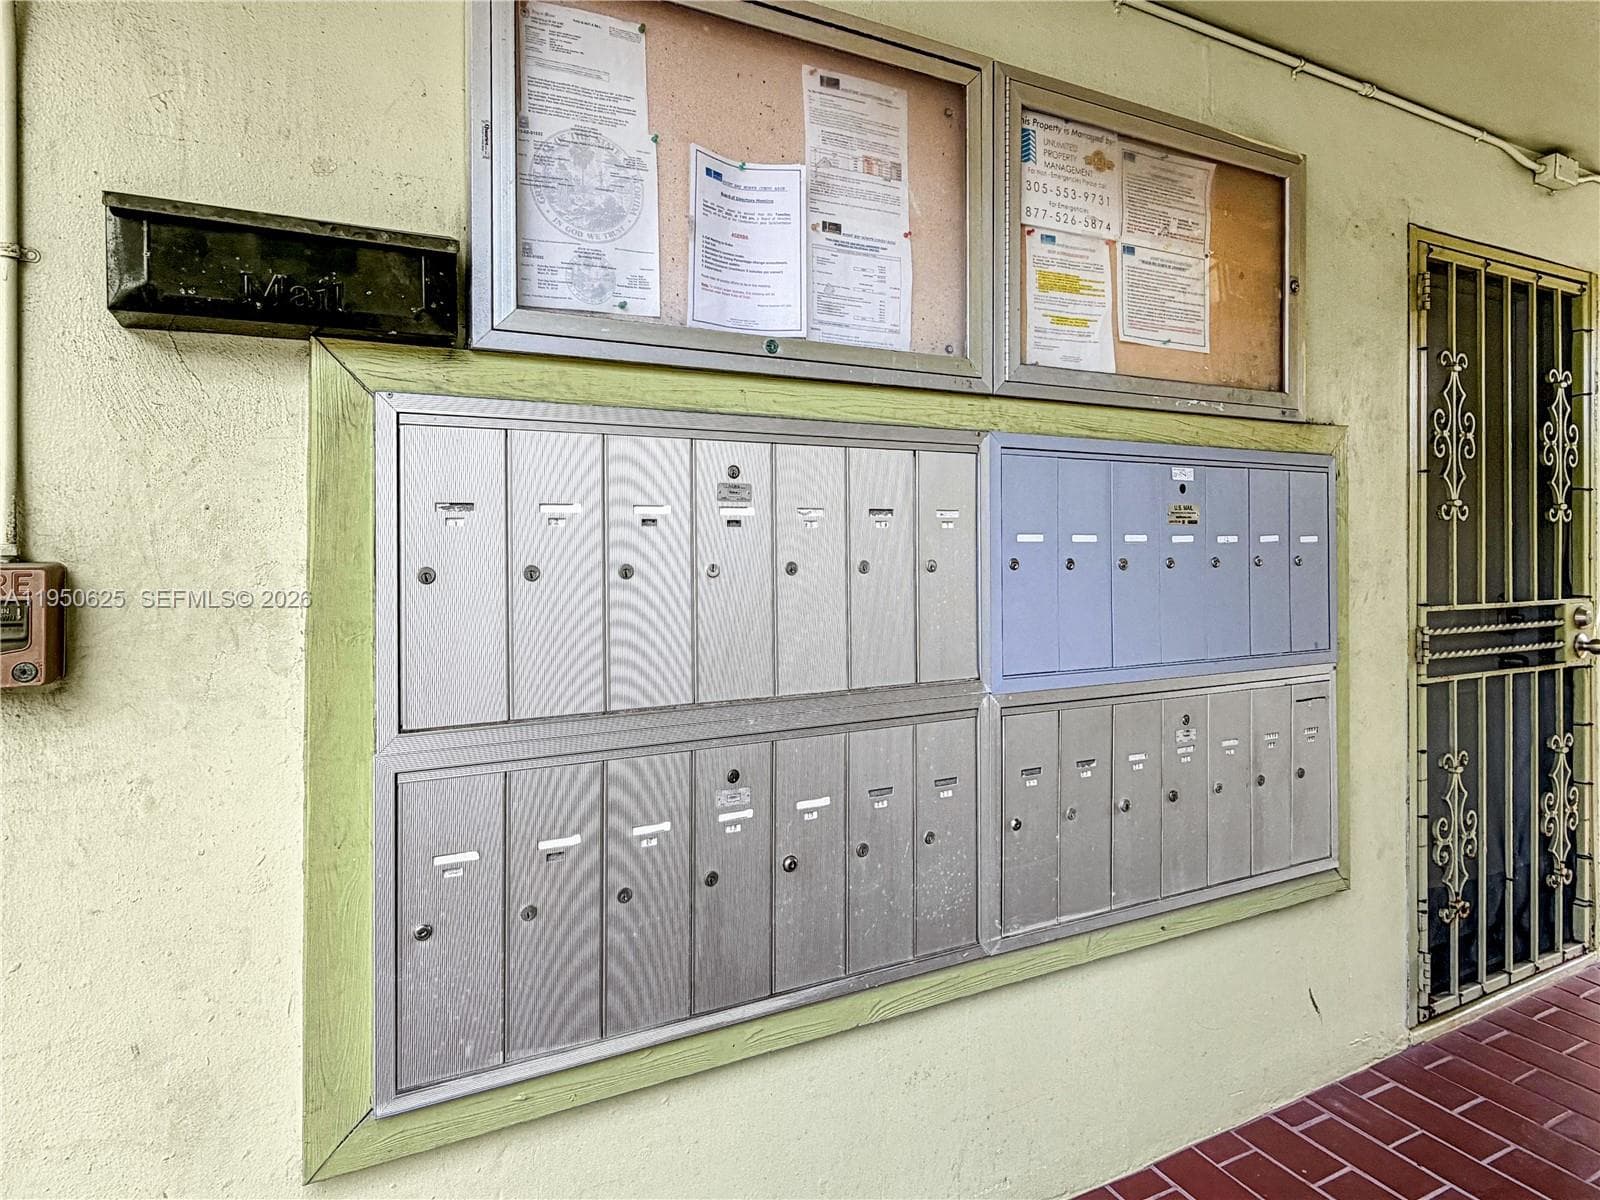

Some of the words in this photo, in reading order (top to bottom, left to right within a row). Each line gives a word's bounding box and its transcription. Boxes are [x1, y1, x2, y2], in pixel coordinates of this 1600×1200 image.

[1032, 118, 1062, 134] Property
[1043, 138, 1078, 152] UNLIMITED
[1043, 148, 1077, 162] PROPERTY
[1044, 161, 1093, 177] MANAGEMENT
[1026, 180, 1110, 207] 305-553-9731
[1025, 206, 1111, 232] 877-526-5874
[565, 226, 584, 238] GOD
[604, 225, 626, 240] TRUST
[240, 270, 344, 312] Mail
